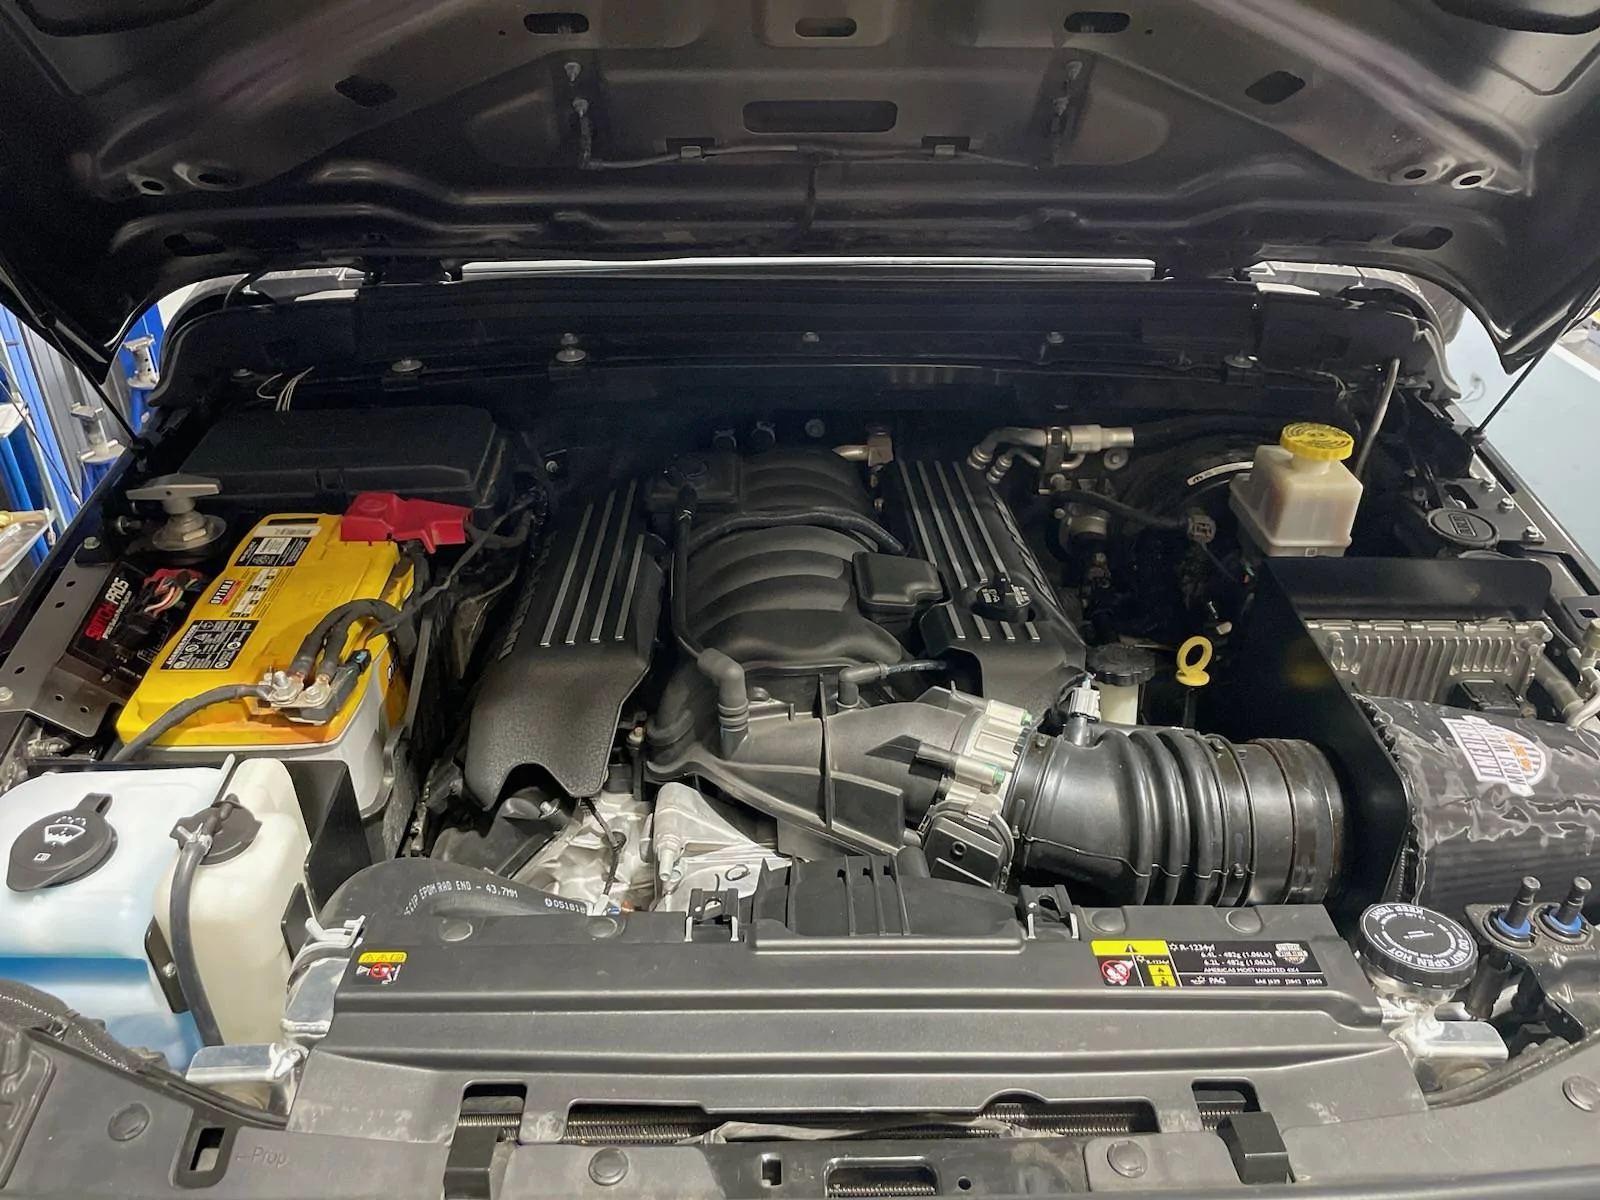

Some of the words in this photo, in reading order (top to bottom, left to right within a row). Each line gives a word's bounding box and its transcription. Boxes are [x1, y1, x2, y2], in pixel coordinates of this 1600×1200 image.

[455, 880, 472, 891] END
[485, 883, 518, 899] 43.7MM
[1369, 906, 1394, 922] TIGHT
[1395, 904, 1424, 916] KEEP
[1179, 943, 1216, 953] R-1234yf
[1457, 938, 1470, 951] DO
[1387, 944, 1414, 963] HOT
[1450, 949, 1469, 965] NOT
[1416, 956, 1451, 968] OPEN
[1208, 977, 1227, 985] PAG
[252, 1145, 288, 1169] Prop
